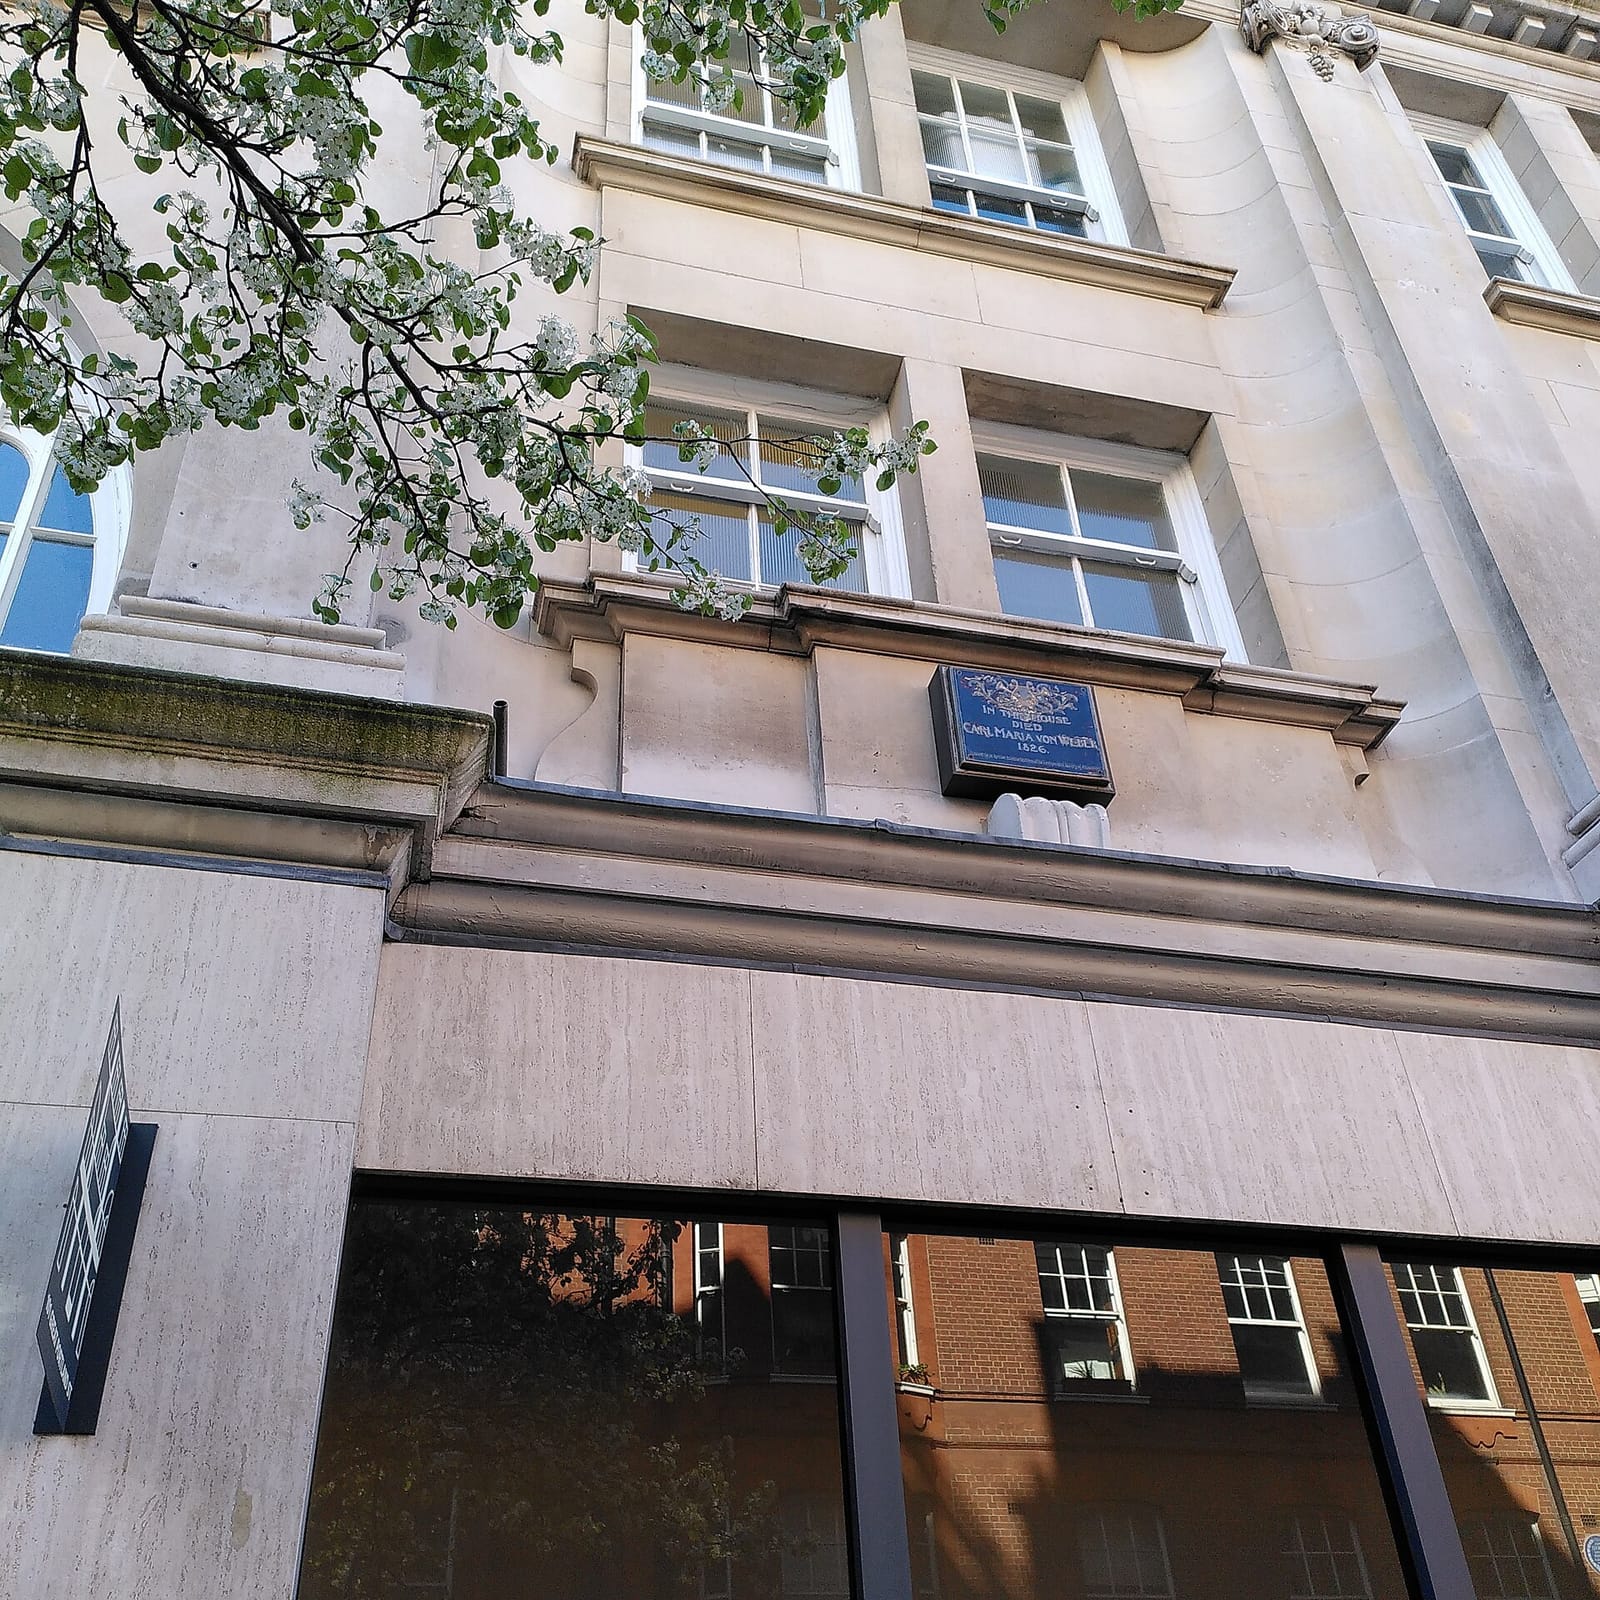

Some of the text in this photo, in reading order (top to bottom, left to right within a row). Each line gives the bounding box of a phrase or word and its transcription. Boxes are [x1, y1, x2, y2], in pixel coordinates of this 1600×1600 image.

[982, 704, 995, 715] IN
[1034, 713, 1071, 725] HOUSE
[963, 722, 994, 738] CARL
[994, 726, 1033, 742] MARIA
[1036, 735, 1058, 745] VON
[1012, 720, 1042, 731] DIED
